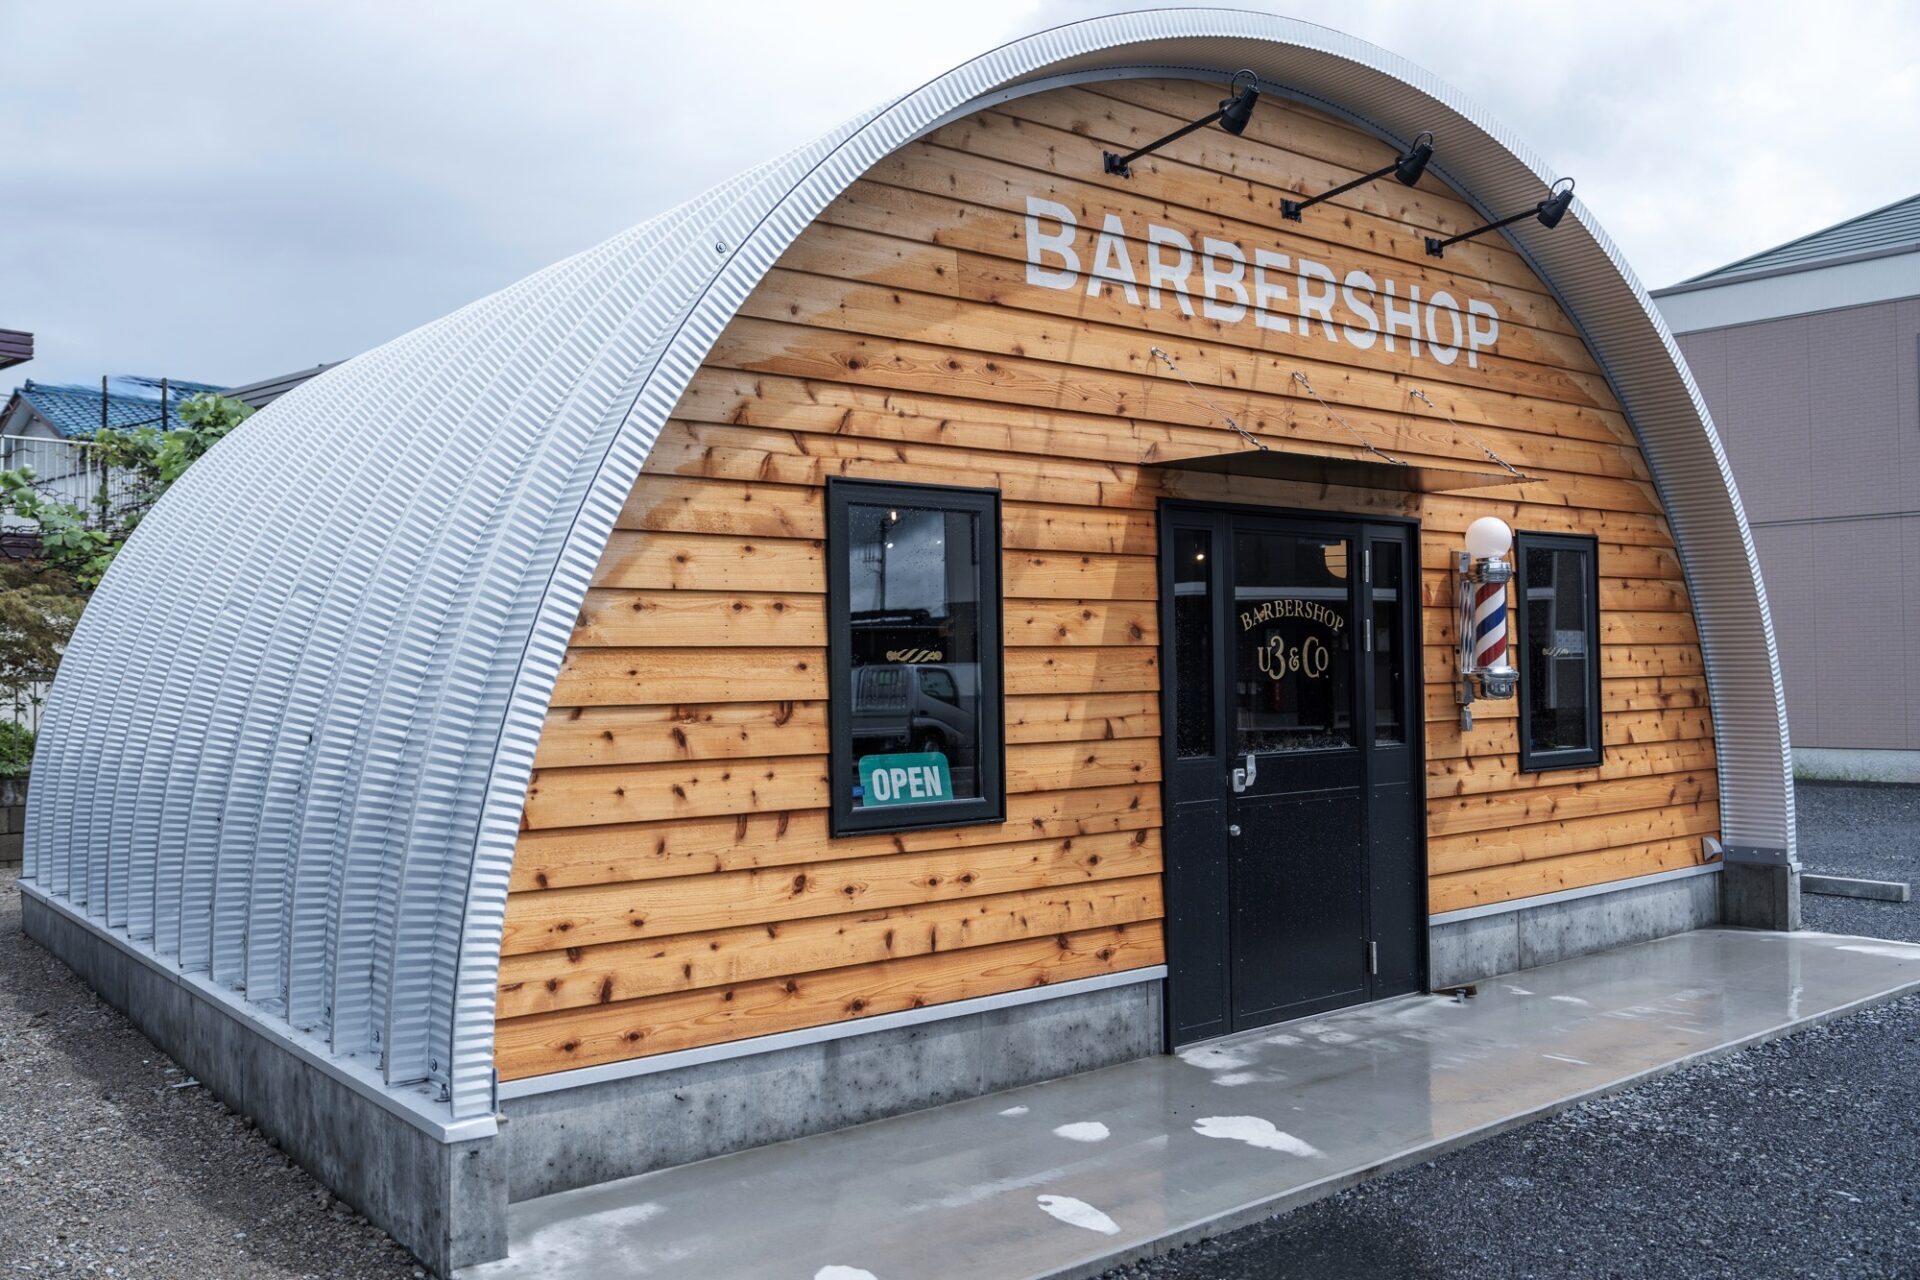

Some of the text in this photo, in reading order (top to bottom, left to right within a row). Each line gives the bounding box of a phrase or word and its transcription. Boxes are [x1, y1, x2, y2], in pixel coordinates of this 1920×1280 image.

[1025, 196, 1499, 368] BARBERSHOP
[1240, 599, 1344, 632] BARBERSHOP
[872, 766, 942, 801] OPEN
